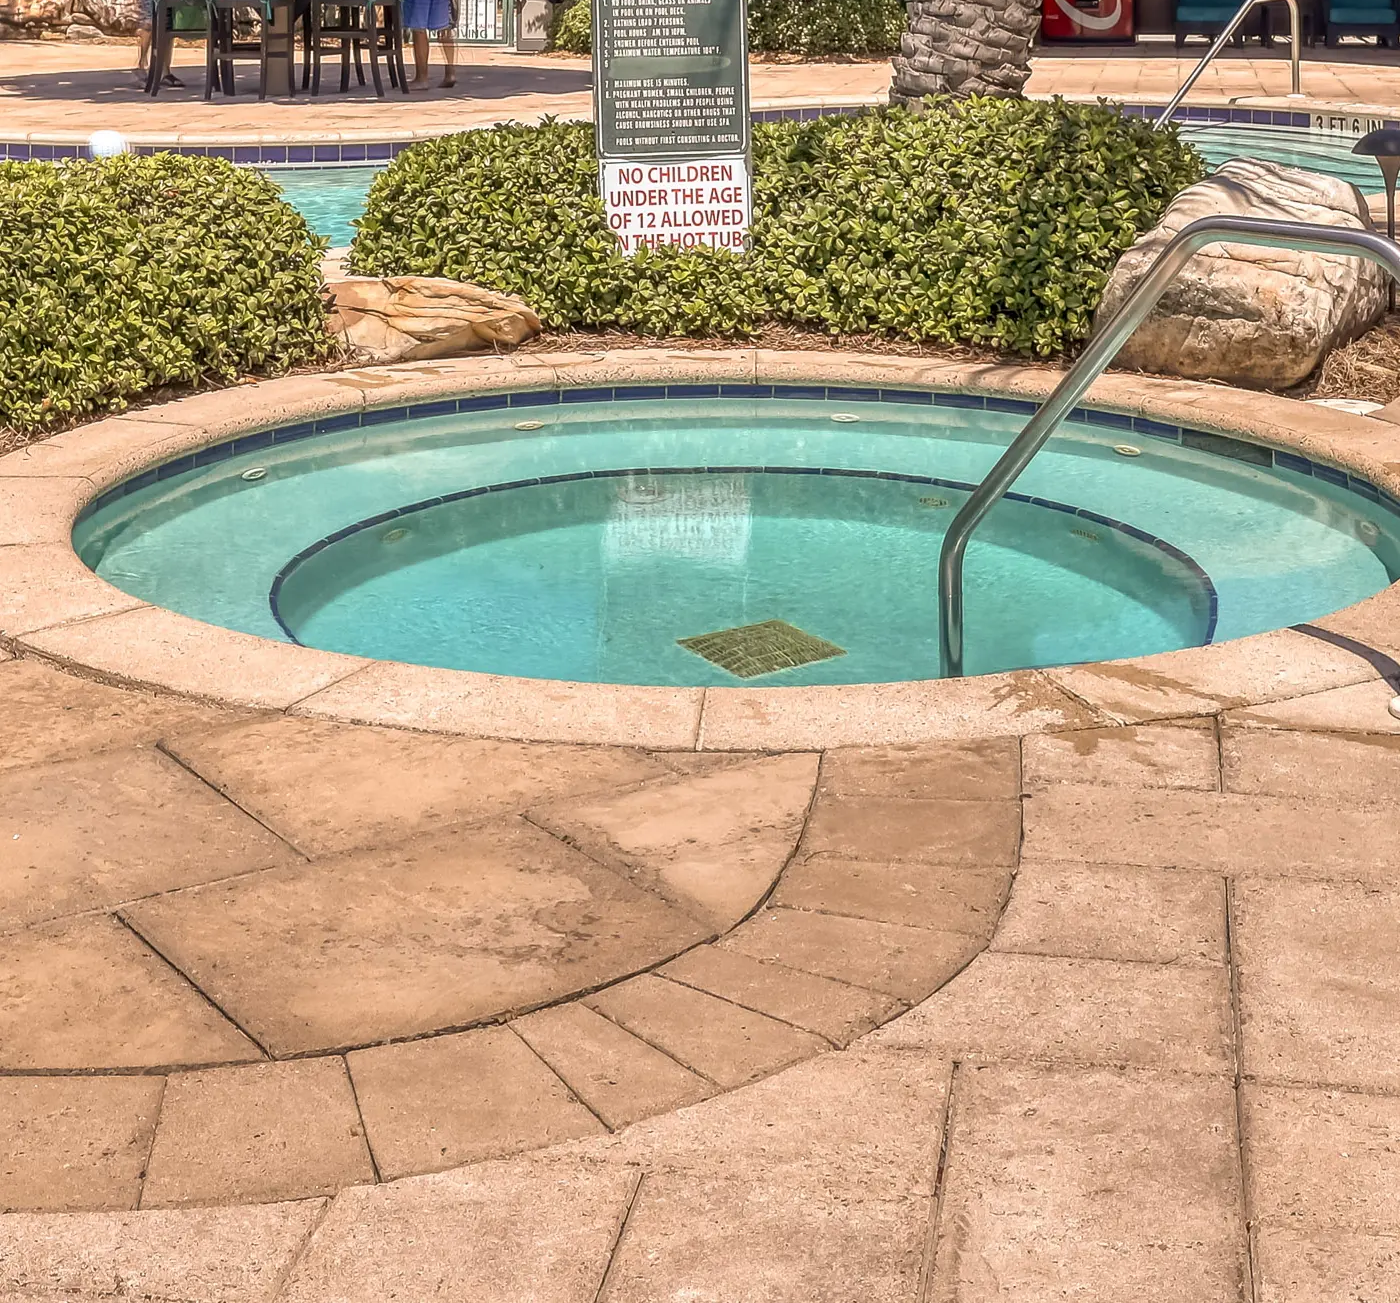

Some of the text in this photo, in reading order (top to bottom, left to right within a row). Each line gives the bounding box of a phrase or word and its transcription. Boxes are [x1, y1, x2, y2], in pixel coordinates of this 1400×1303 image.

[614, 19, 636, 27] BATHING
[638, 18, 652, 26] LOAD
[604, 30, 609, 38] 3.
[652, 28, 661, 36] AM
[638, 39, 657, 47] BEFORE
[659, 38, 684, 46] ENTERING
[614, 49, 641, 57] MAXIMUM
[643, 48, 661, 56] WATER
[663, 47, 700, 55] TEMPERATURE
[643, 79, 654, 87] USE
[663, 78, 689, 86] MINUTES.
[613, 90, 641, 98] PREGNANT
[716, 87, 734, 95] PEOPLE
[643, 110, 672, 118] NARCOTICS
[703, 108, 720, 116] DRUGS
[722, 107, 735, 115] THAT
[616, 121, 633, 129] CAUSE
[635, 120, 670, 128] DROWSINESS
[1330, 117, 1346, 132] FT
[635, 137, 658, 145] WITHOUT
[660, 136, 675, 144] FIRST
[677, 135, 710, 143] CONSULTING
[618, 165, 732, 185] NO CHILDREN
[610, 187, 742, 207] UNDER THE AGE
[610, 210, 743, 229] OF 12 ALLOWED
